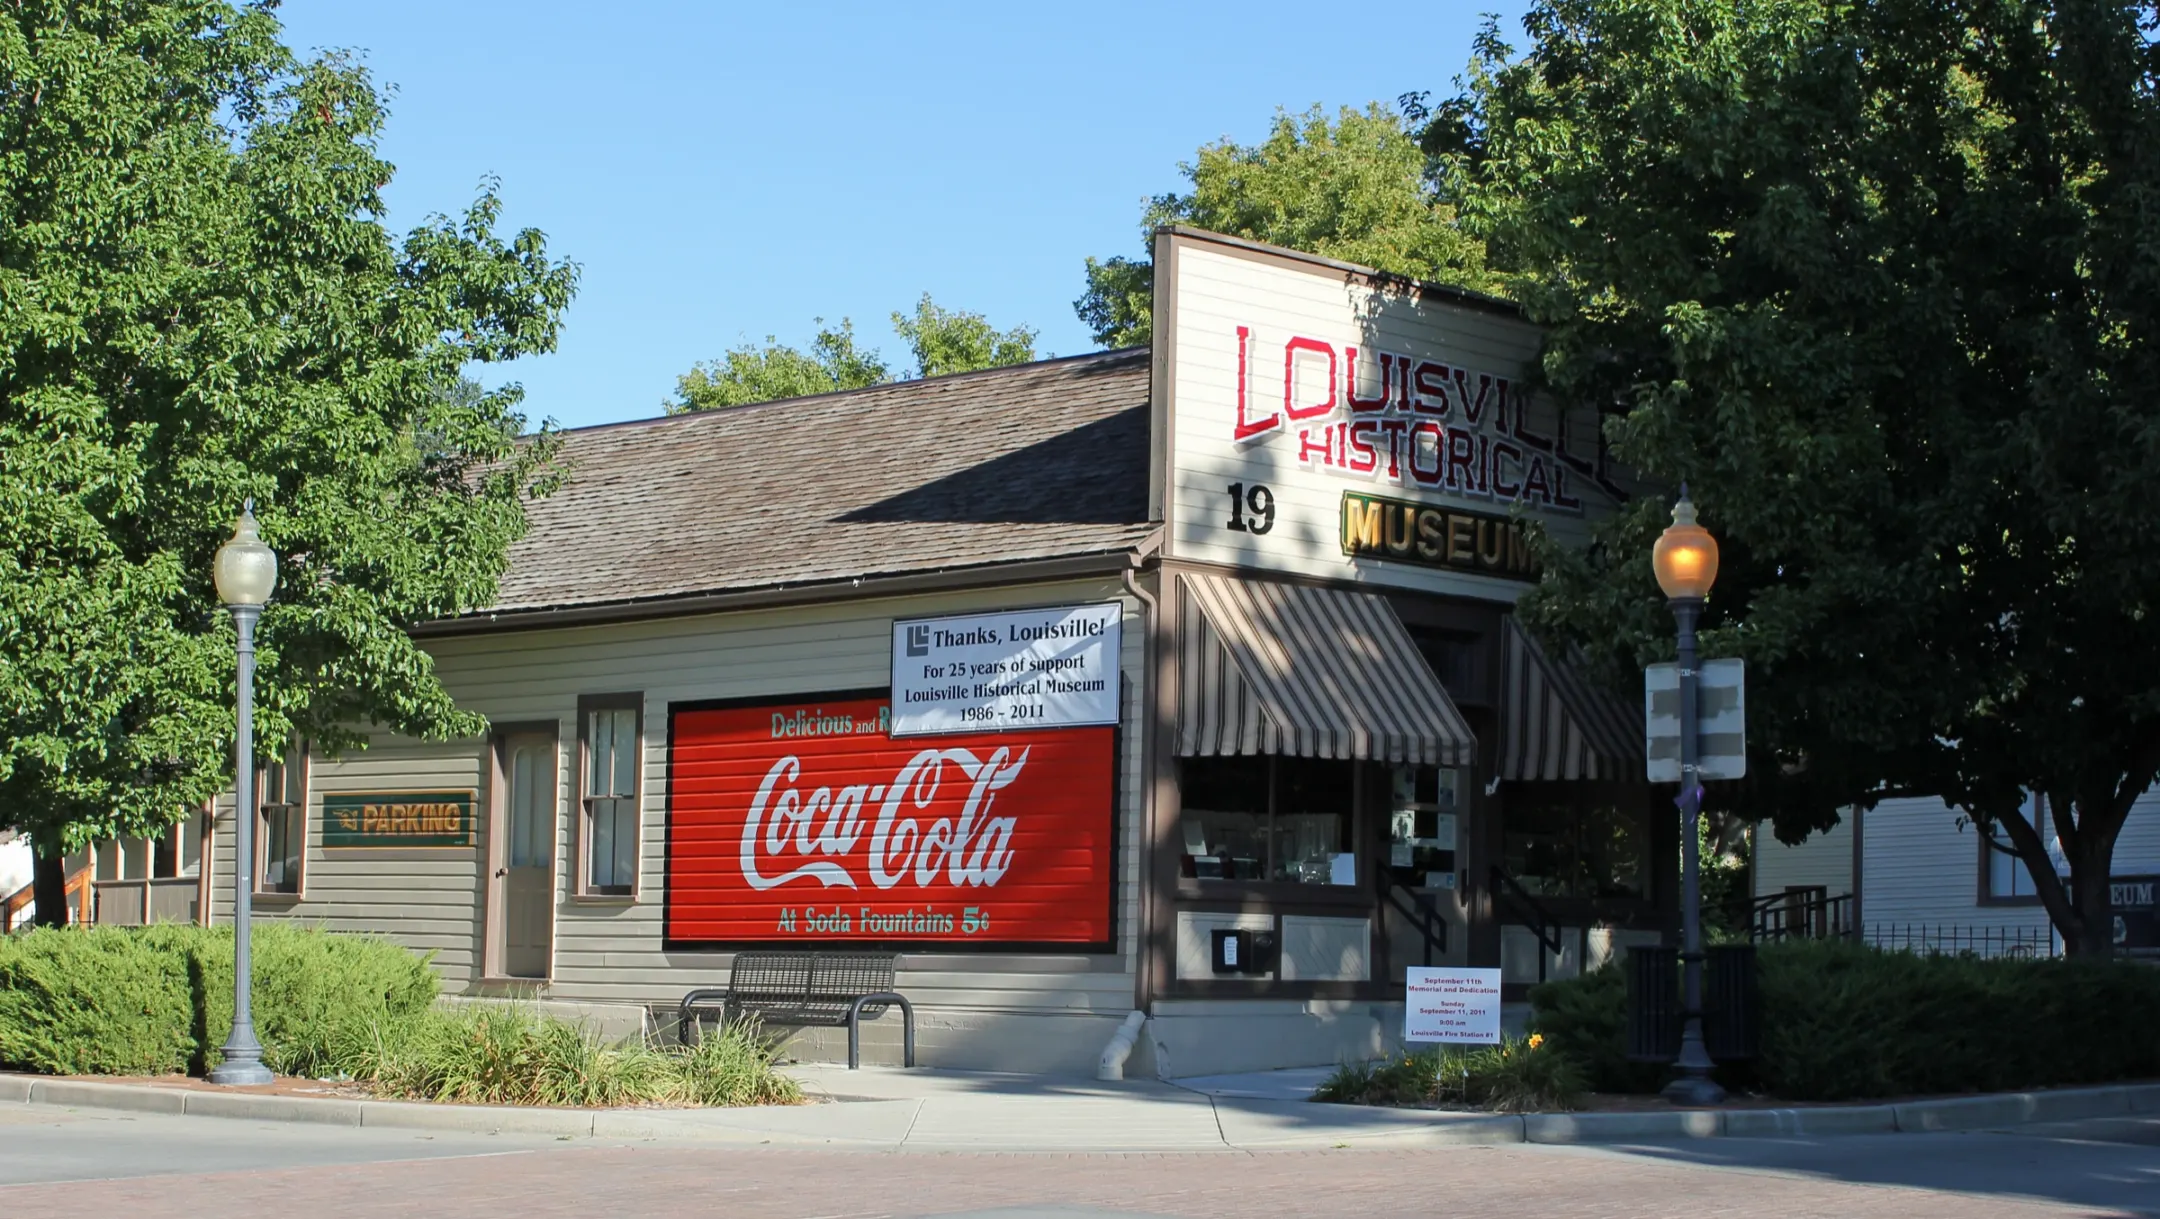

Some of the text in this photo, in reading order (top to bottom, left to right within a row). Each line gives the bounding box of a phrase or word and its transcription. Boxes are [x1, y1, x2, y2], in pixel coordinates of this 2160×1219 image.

[1298, 419, 1580, 509] HISTORICAL
[1226, 482, 1276, 535] 19
[933, 618, 1105, 648] Thanks, Louisville!
[923, 654, 1085, 680] For 25 years of support
[905, 679, 1105, 703] Louisville Historical Museum
[771, 708, 853, 738] Delicious
[855, 717, 876, 733] and
[960, 706, 994, 722] 1986
[1010, 703, 1044, 719] 2011
[363, 803, 461, 835] PARKING
[740, 744, 1031, 891] Coca-Cola
[777, 907, 797, 932] At
[805, 906, 851, 933] Soda
[860, 904, 953, 933] Fountains
[1420, 1008, 1456, 1016] September
[1458, 1008, 1468, 1016] 11,
